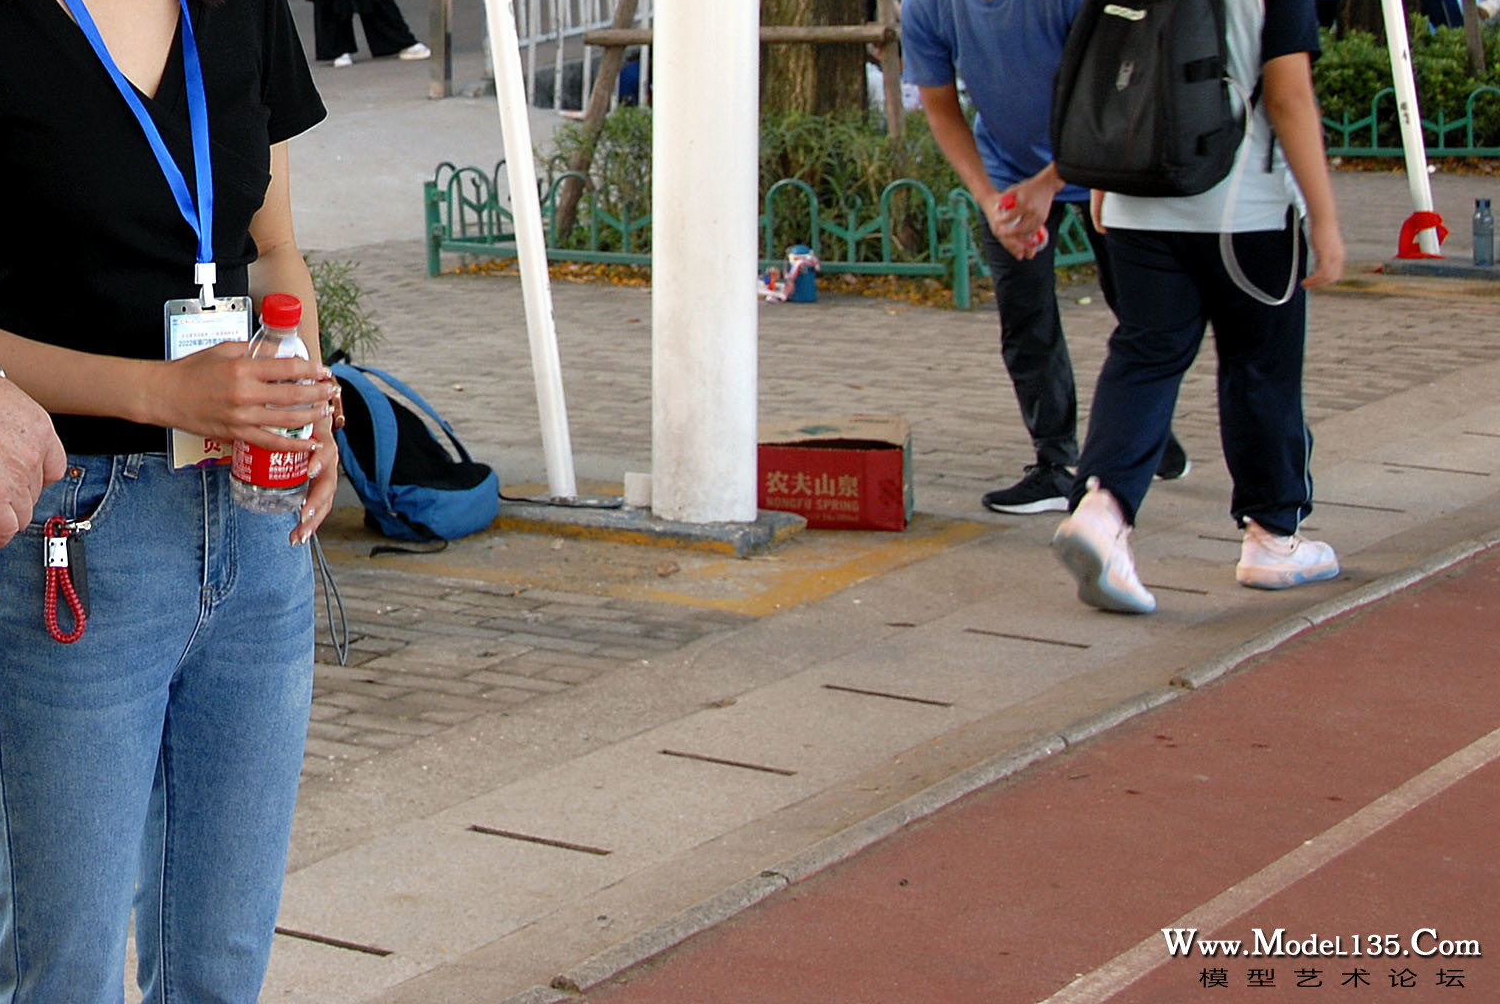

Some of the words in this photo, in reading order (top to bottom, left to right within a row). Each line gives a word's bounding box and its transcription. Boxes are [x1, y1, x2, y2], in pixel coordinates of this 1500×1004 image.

[765, 470, 860, 498] 农夫山泉
[817, 499, 859, 512] SPRING
